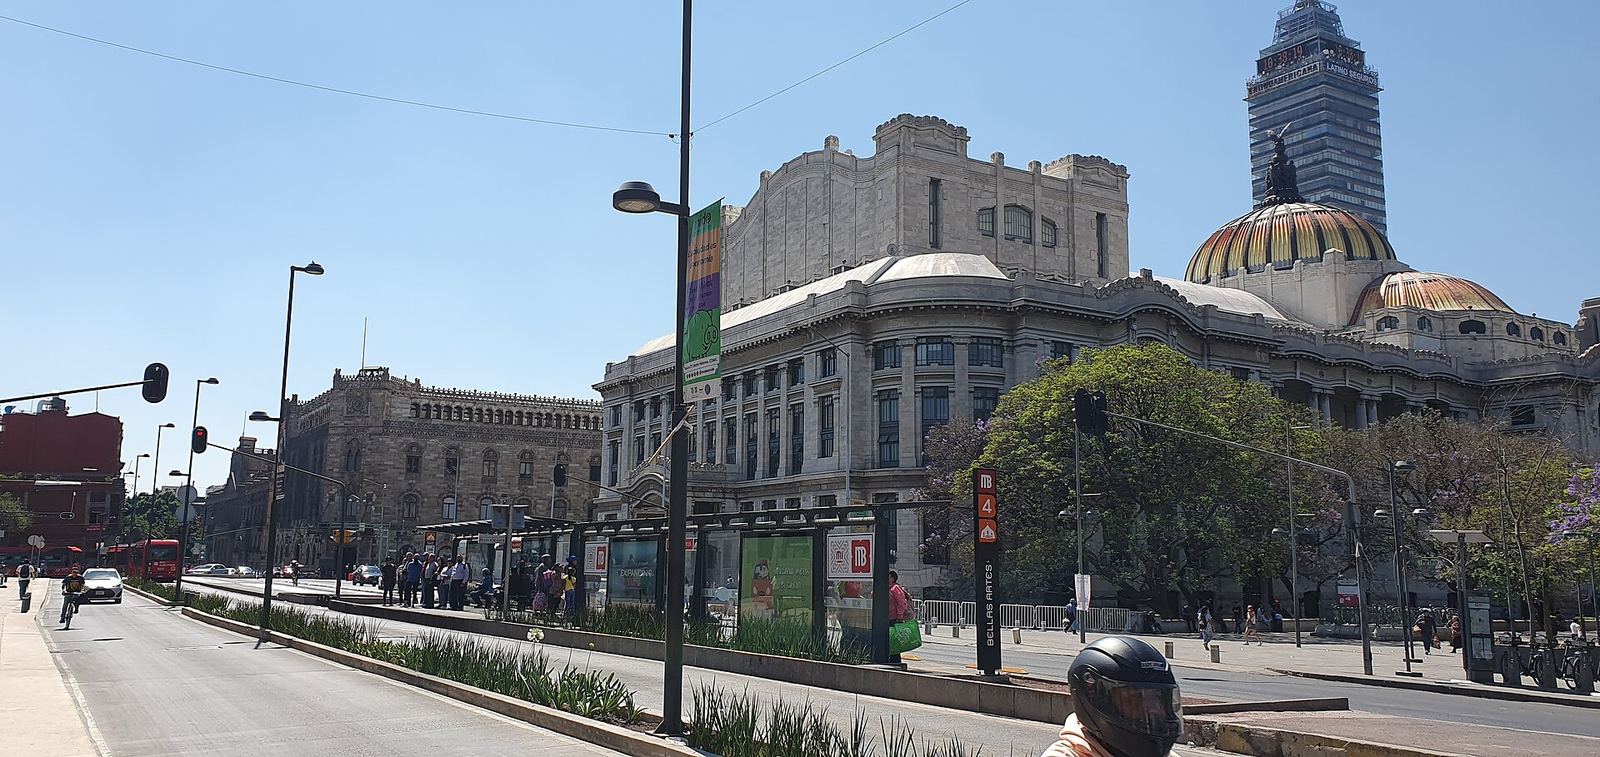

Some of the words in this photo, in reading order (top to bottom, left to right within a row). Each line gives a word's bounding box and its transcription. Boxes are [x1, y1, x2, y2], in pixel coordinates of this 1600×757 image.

[1326, 62, 1348, 76] LATINO
[1349, 69, 1377, 86] SEGUROS
[982, 498, 992, 514] 4
[985, 564, 993, 601] ARTES
[986, 603, 994, 647] BELLAS
